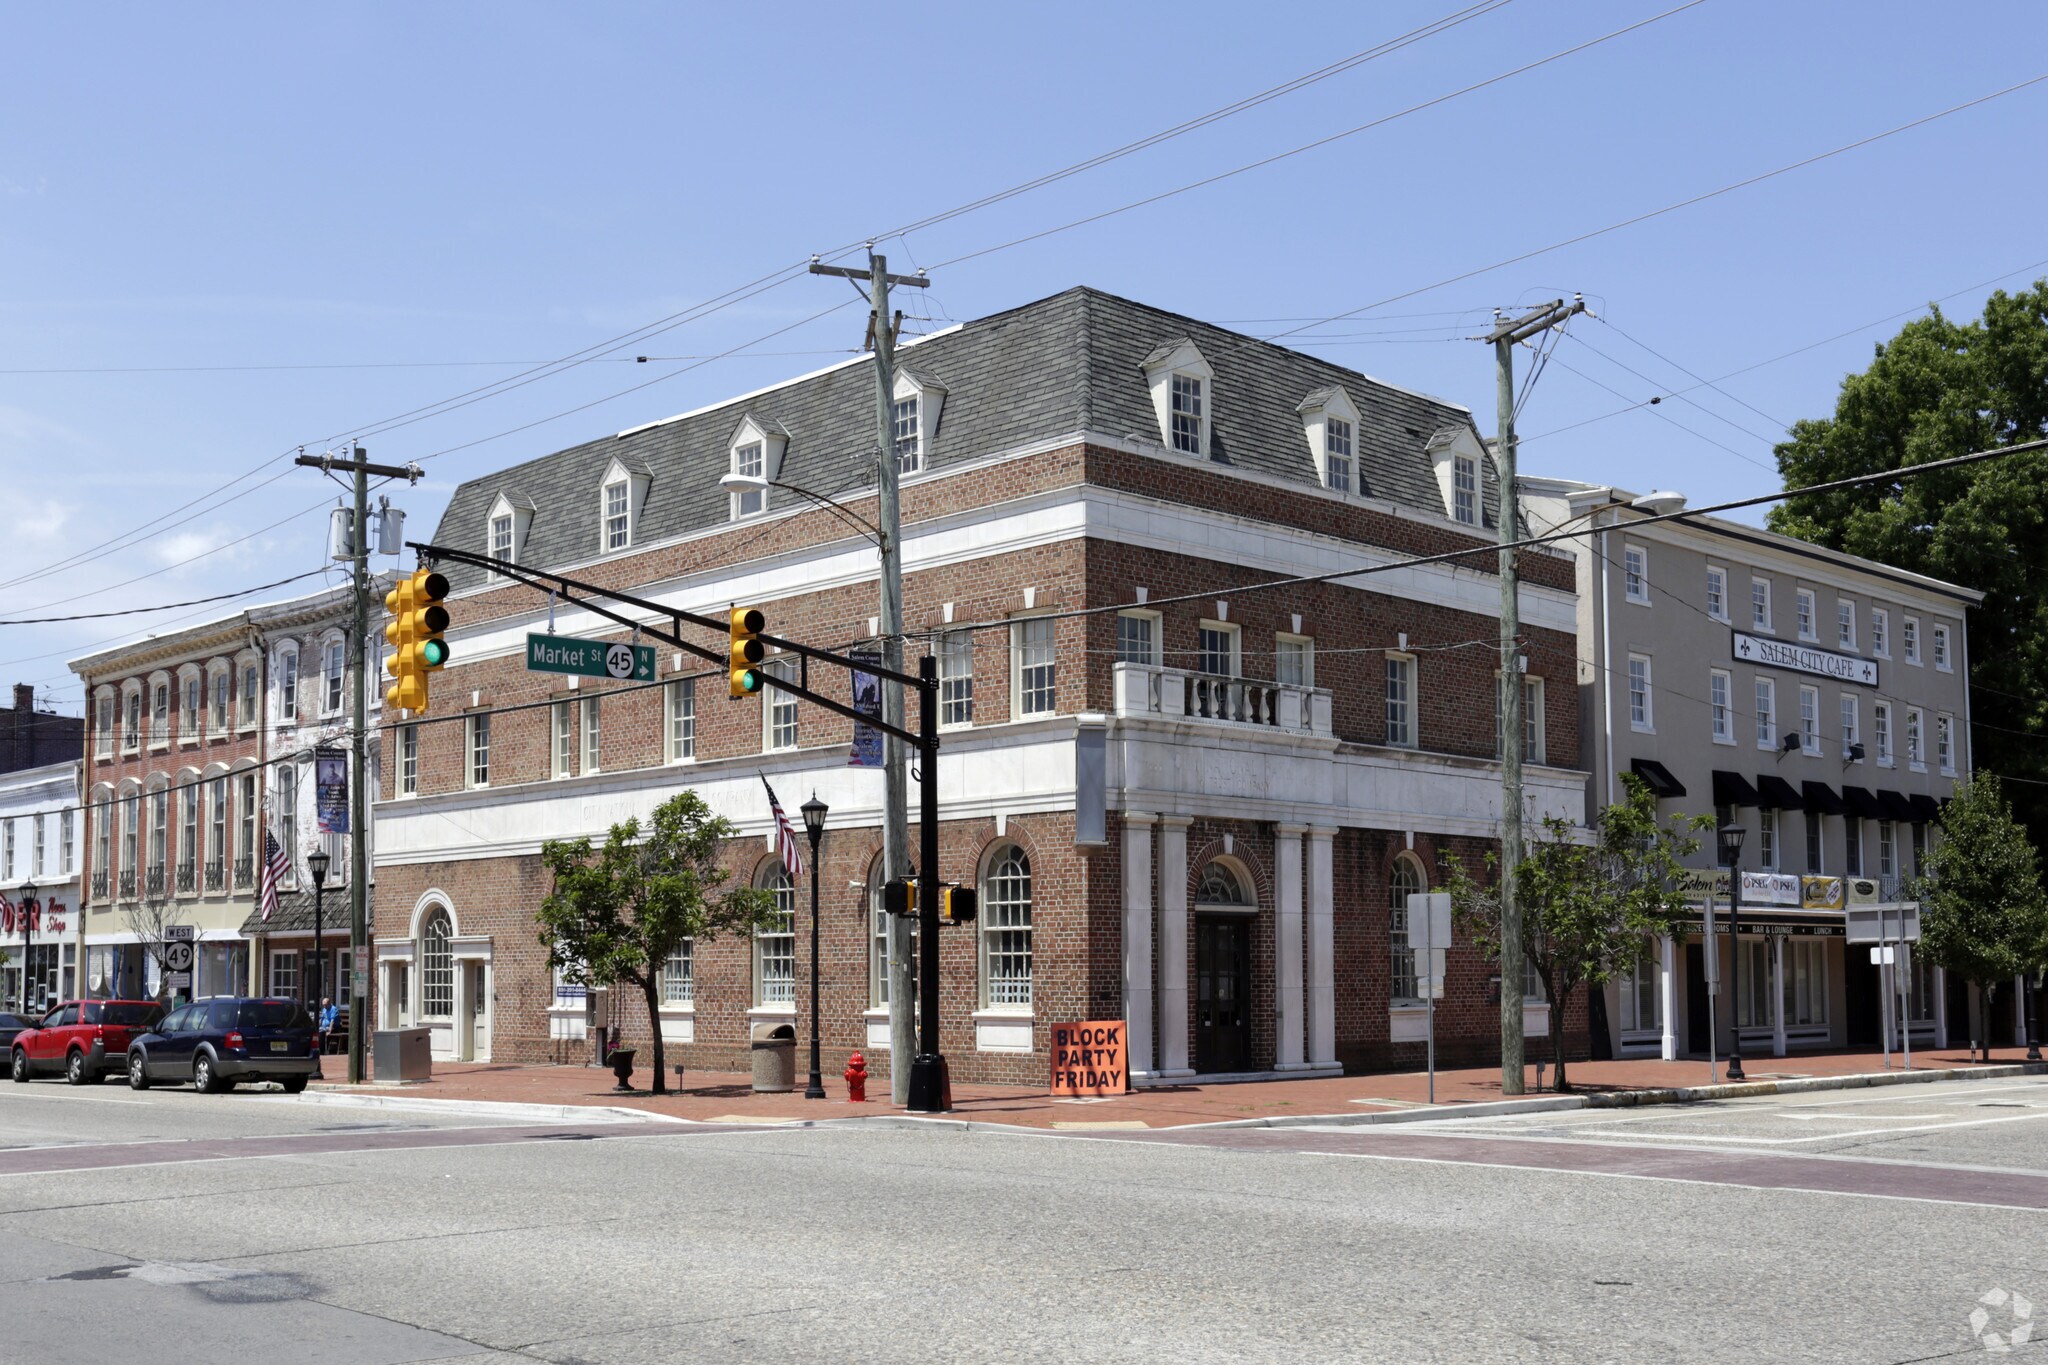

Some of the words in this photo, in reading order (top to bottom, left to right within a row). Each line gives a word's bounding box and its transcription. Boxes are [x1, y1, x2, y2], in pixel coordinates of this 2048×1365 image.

[533, 642, 585, 667] Market
[591, 649, 601, 662] St
[608, 651, 631, 671] 45
[641, 650, 648, 662] N
[1760, 642, 1798, 667] SALEM
[1800, 650, 1826, 672] CITY
[1827, 656, 1854, 678] CAFE
[47, 916, 66, 936] Shop
[168, 928, 191, 937] WEST
[1752, 925, 1764, 933] BAR
[1771, 925, 1793, 935] LOUNGE
[1814, 927, 1832, 935] LUNCH
[168, 948, 190, 965] 49
[1057, 1027, 1119, 1047] BLOCK
[1058, 1049, 1117, 1067] PARTY
[1055, 1070, 1121, 1089] FRIDAY
